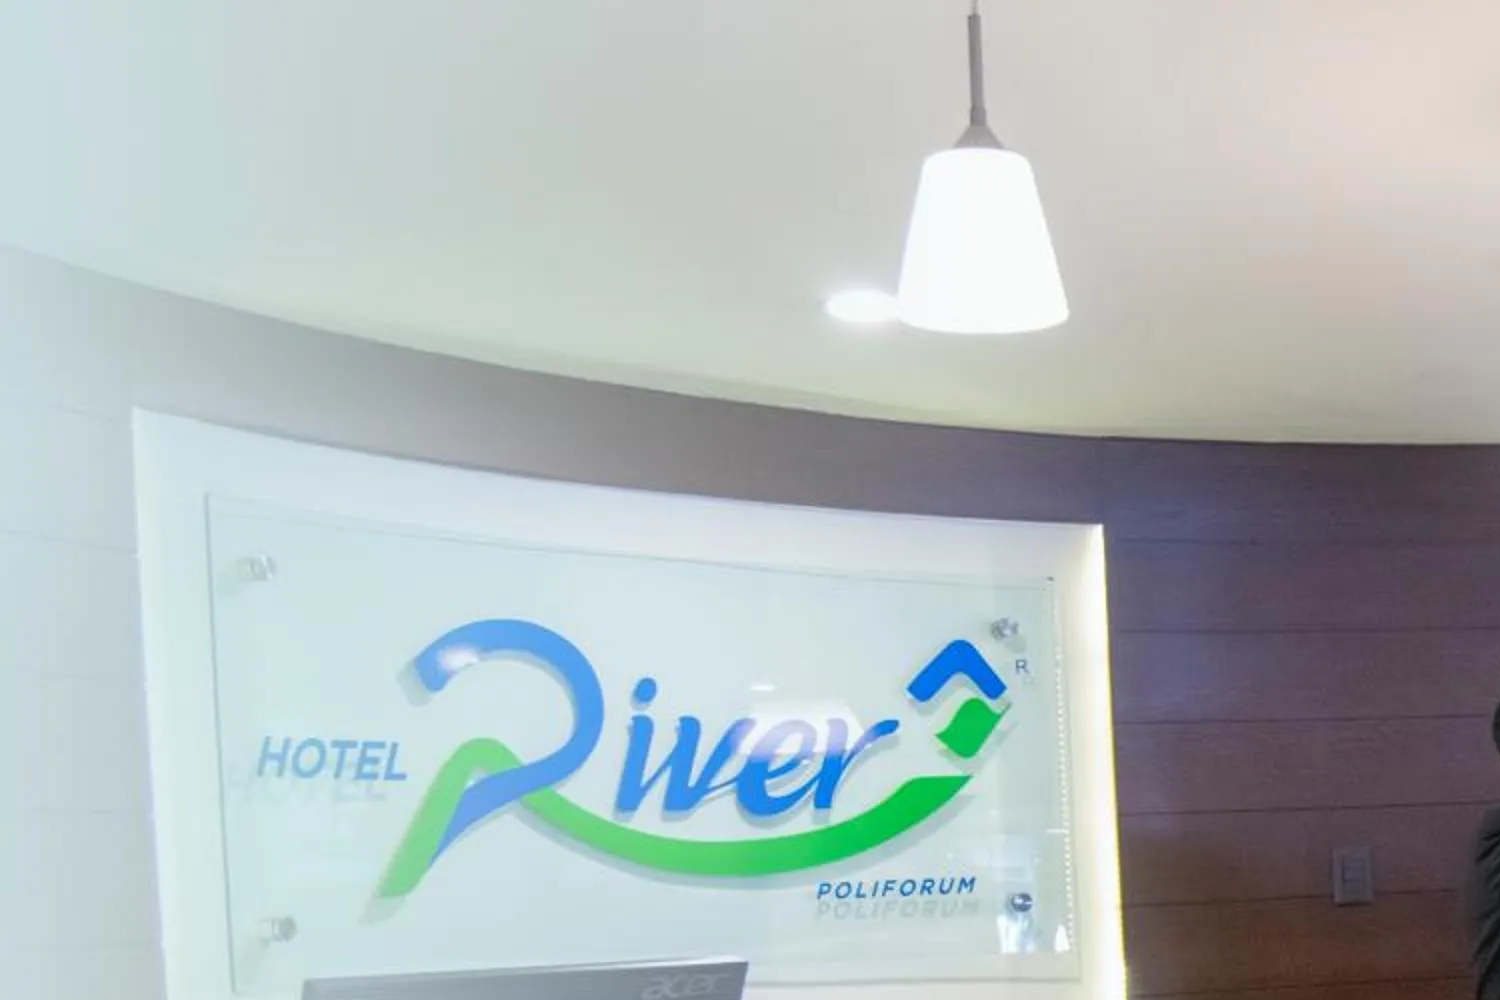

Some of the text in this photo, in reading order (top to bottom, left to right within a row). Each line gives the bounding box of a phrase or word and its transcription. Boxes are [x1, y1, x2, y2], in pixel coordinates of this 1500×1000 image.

[256, 618, 900, 898] HOTEL River
[817, 876, 977, 900] POLIFORUM
